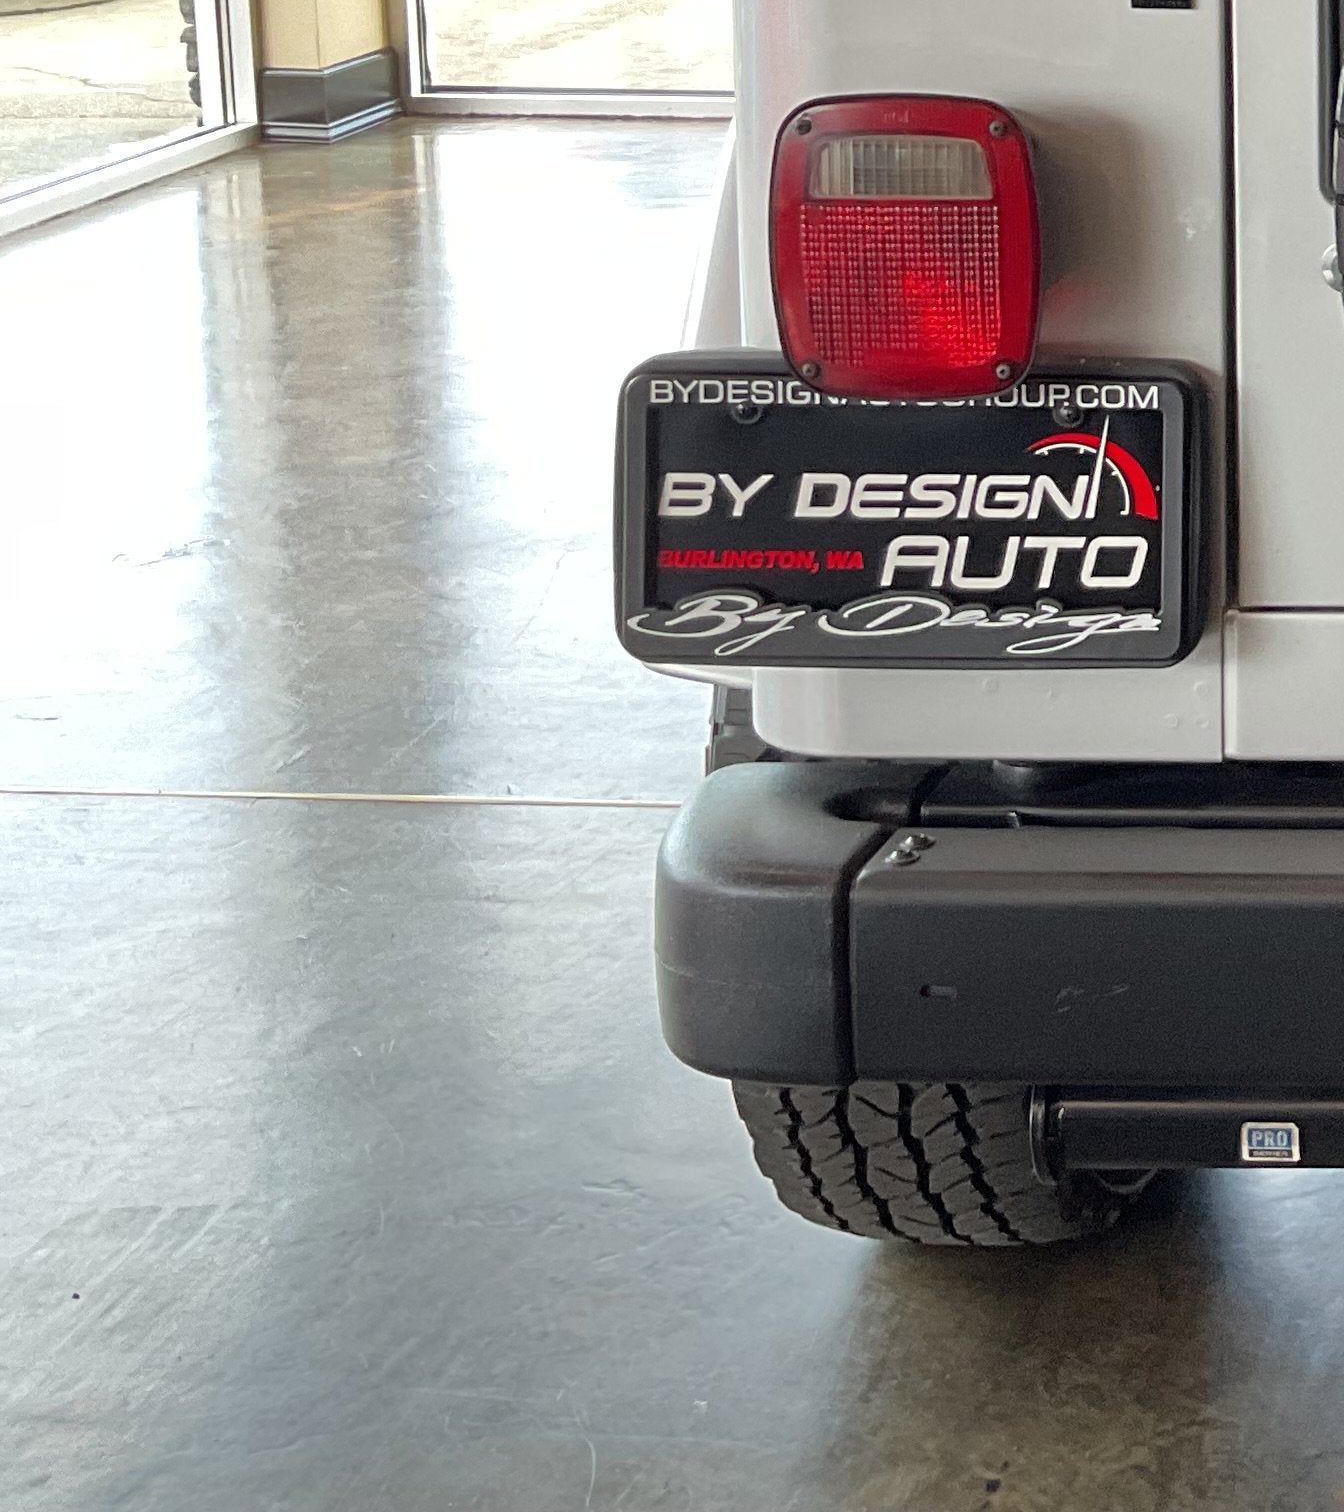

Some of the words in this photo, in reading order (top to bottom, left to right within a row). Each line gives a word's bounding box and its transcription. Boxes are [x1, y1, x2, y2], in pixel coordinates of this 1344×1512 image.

[650, 379, 1159, 409] BYDESIGOUP.COM
[659, 473, 774, 518] BY
[795, 474, 1092, 520] DESIGN
[658, 550, 820, 573] BURLINGTON,
[826, 551, 864, 569] WA
[879, 536, 1149, 589] AUTO
[627, 595, 806, 656] By
[818, 596, 1162, 654] Design
[1251, 1130, 1289, 1147] PRO
